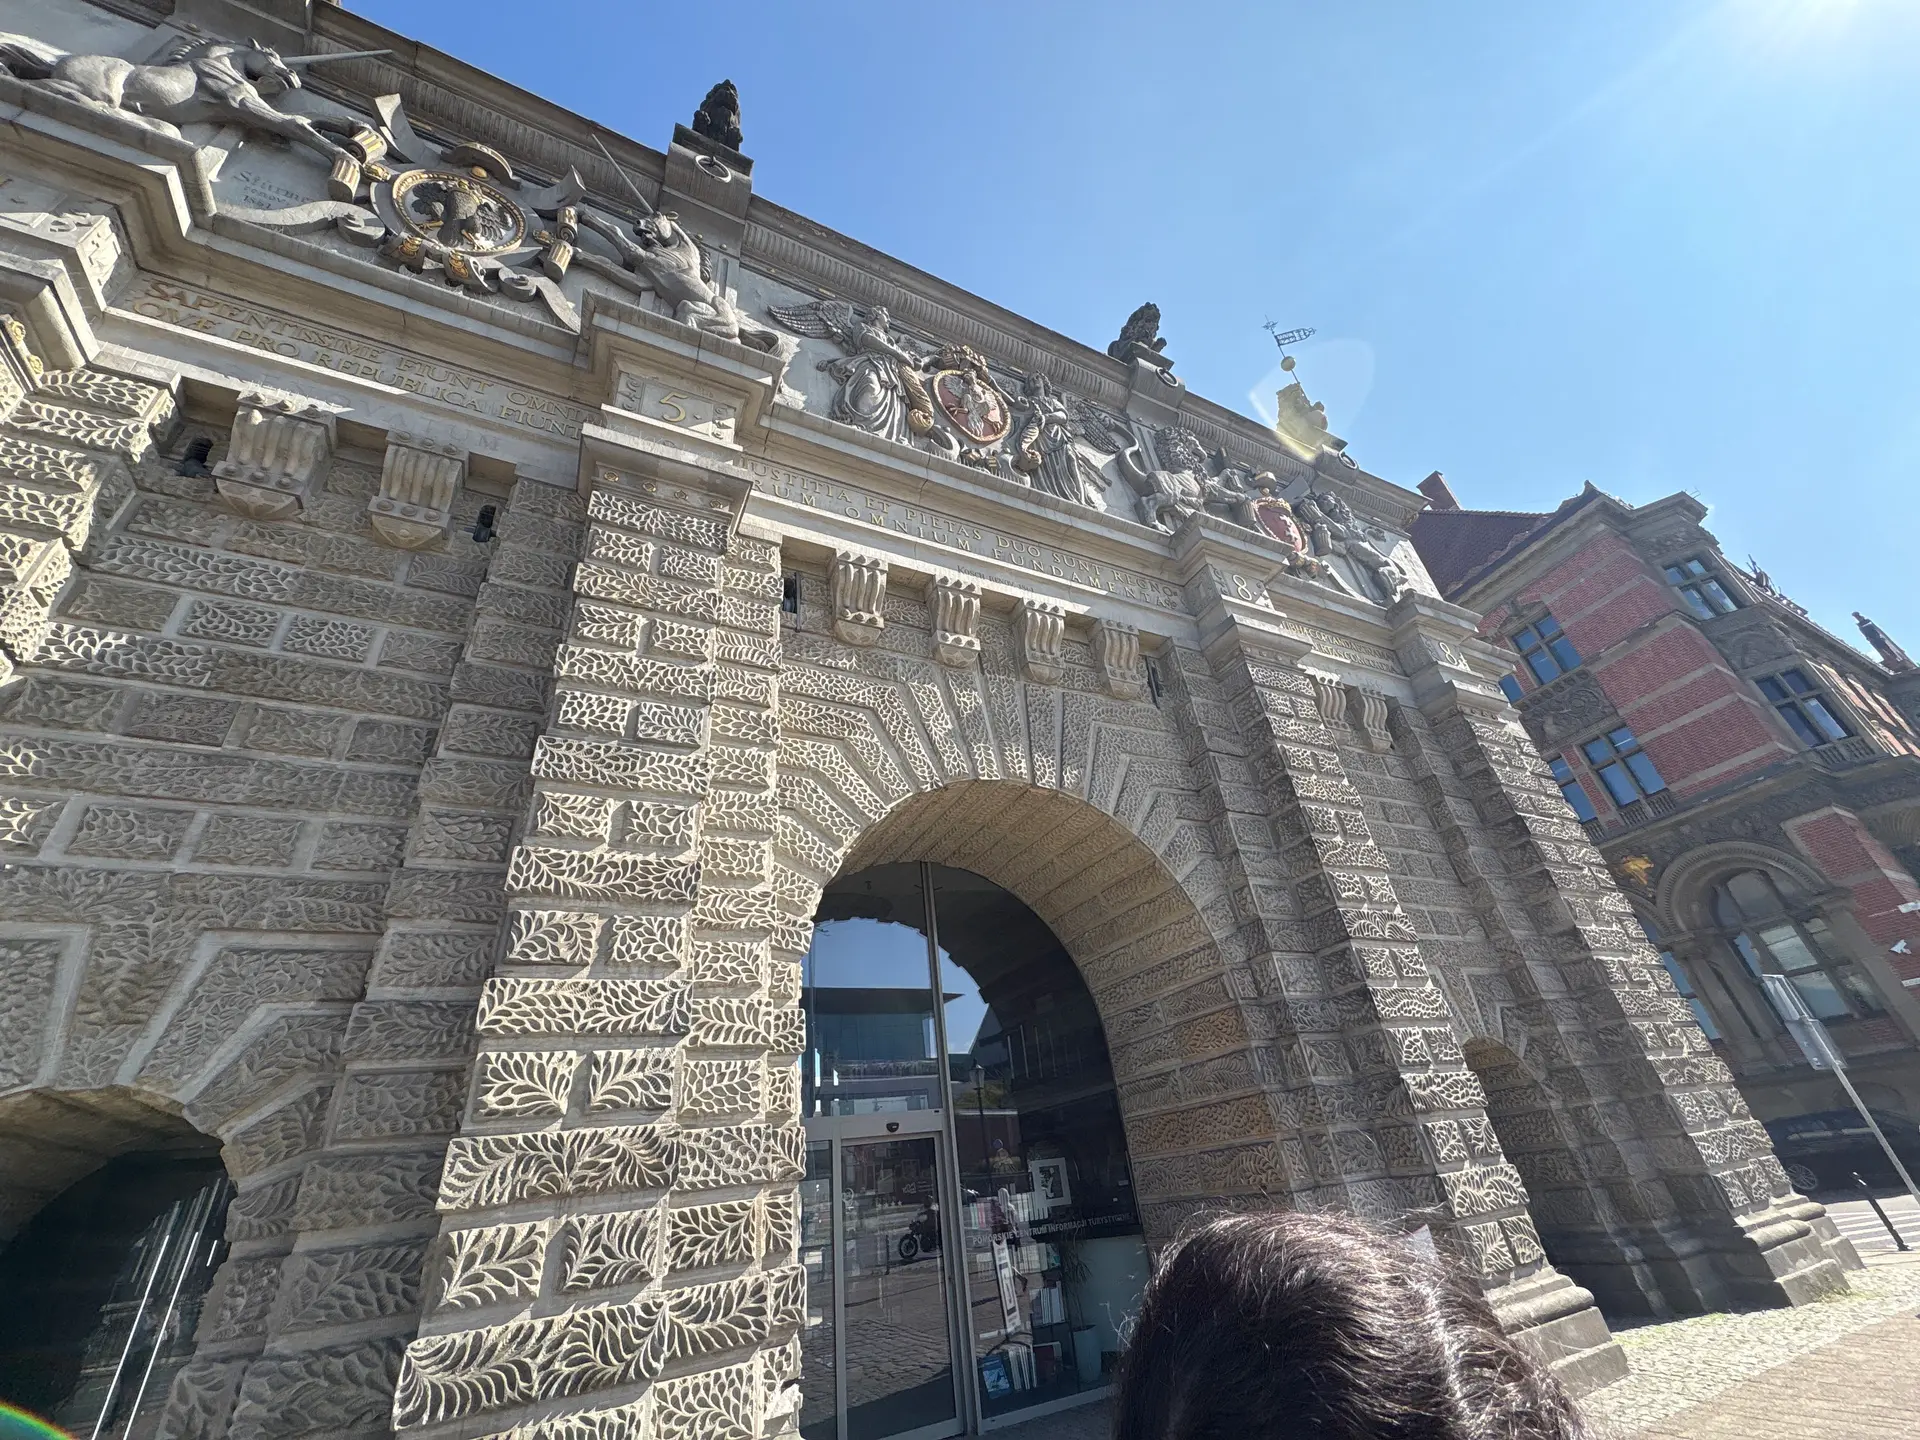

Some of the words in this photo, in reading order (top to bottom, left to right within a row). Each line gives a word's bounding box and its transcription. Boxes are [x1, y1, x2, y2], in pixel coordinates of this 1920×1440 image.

[230, 327, 300, 358] PRO
[312, 350, 483, 413] REPUBLICA
[497, 405, 582, 441] FIUNT
[396, 357, 494, 395] FIUNT
[738, 455, 853, 504] IUSTITIA
[865, 496, 892, 514] ET
[905, 508, 982, 541] PIETAS
[996, 535, 1041, 557] DUO
[1052, 552, 1103, 576] SUNT
[751, 479, 817, 507] RUM
[844, 506, 971, 552] OMNIUM
[992, 548, 1168, 608] FUNDAMENTA
[1014, 1225, 1048, 1239] CENTRUM
